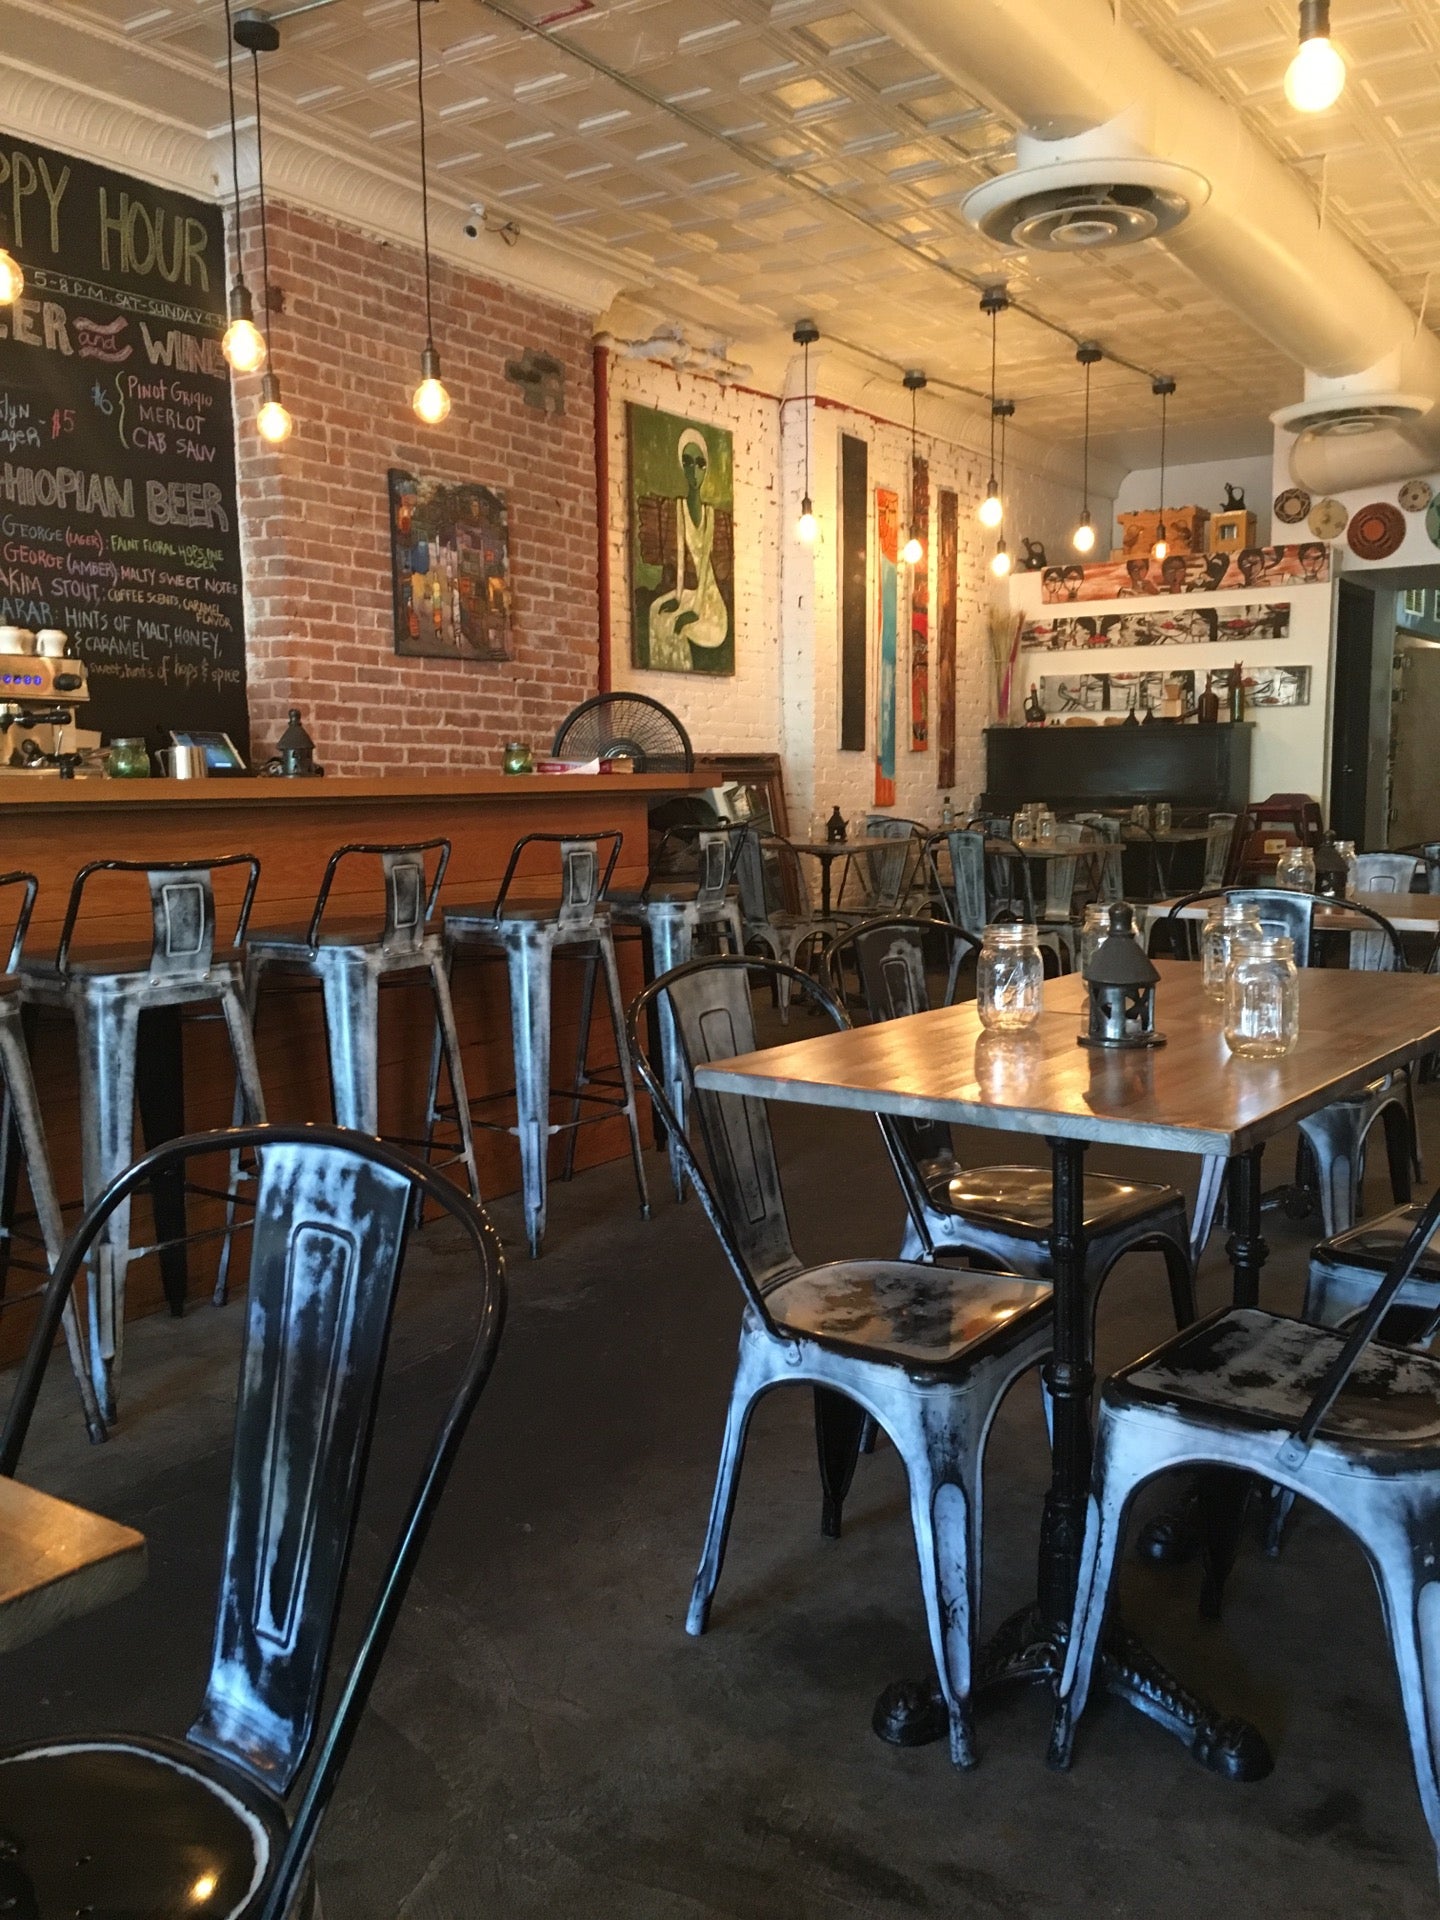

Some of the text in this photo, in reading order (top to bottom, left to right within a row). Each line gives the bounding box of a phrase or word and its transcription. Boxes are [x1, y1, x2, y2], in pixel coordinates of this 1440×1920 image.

[99, 186, 209, 292] HOUR
[78, 332, 118, 351] and
[139, 321, 226, 380] WINE
[139, 404, 206, 435] MERLOT
[132, 427, 216, 462] CAB SAUV
[146, 479, 229, 532] BEER
[2, 513, 63, 542] GEORGE
[4, 541, 64, 570] GEORGE
[120, 565, 156, 586] MALTY
[159, 571, 200, 590] SWEET
[205, 578, 239, 595] NOTES
[65, 606, 108, 631] HINTS
[113, 615, 132, 632] OF
[85, 636, 149, 660] CARAMEL
